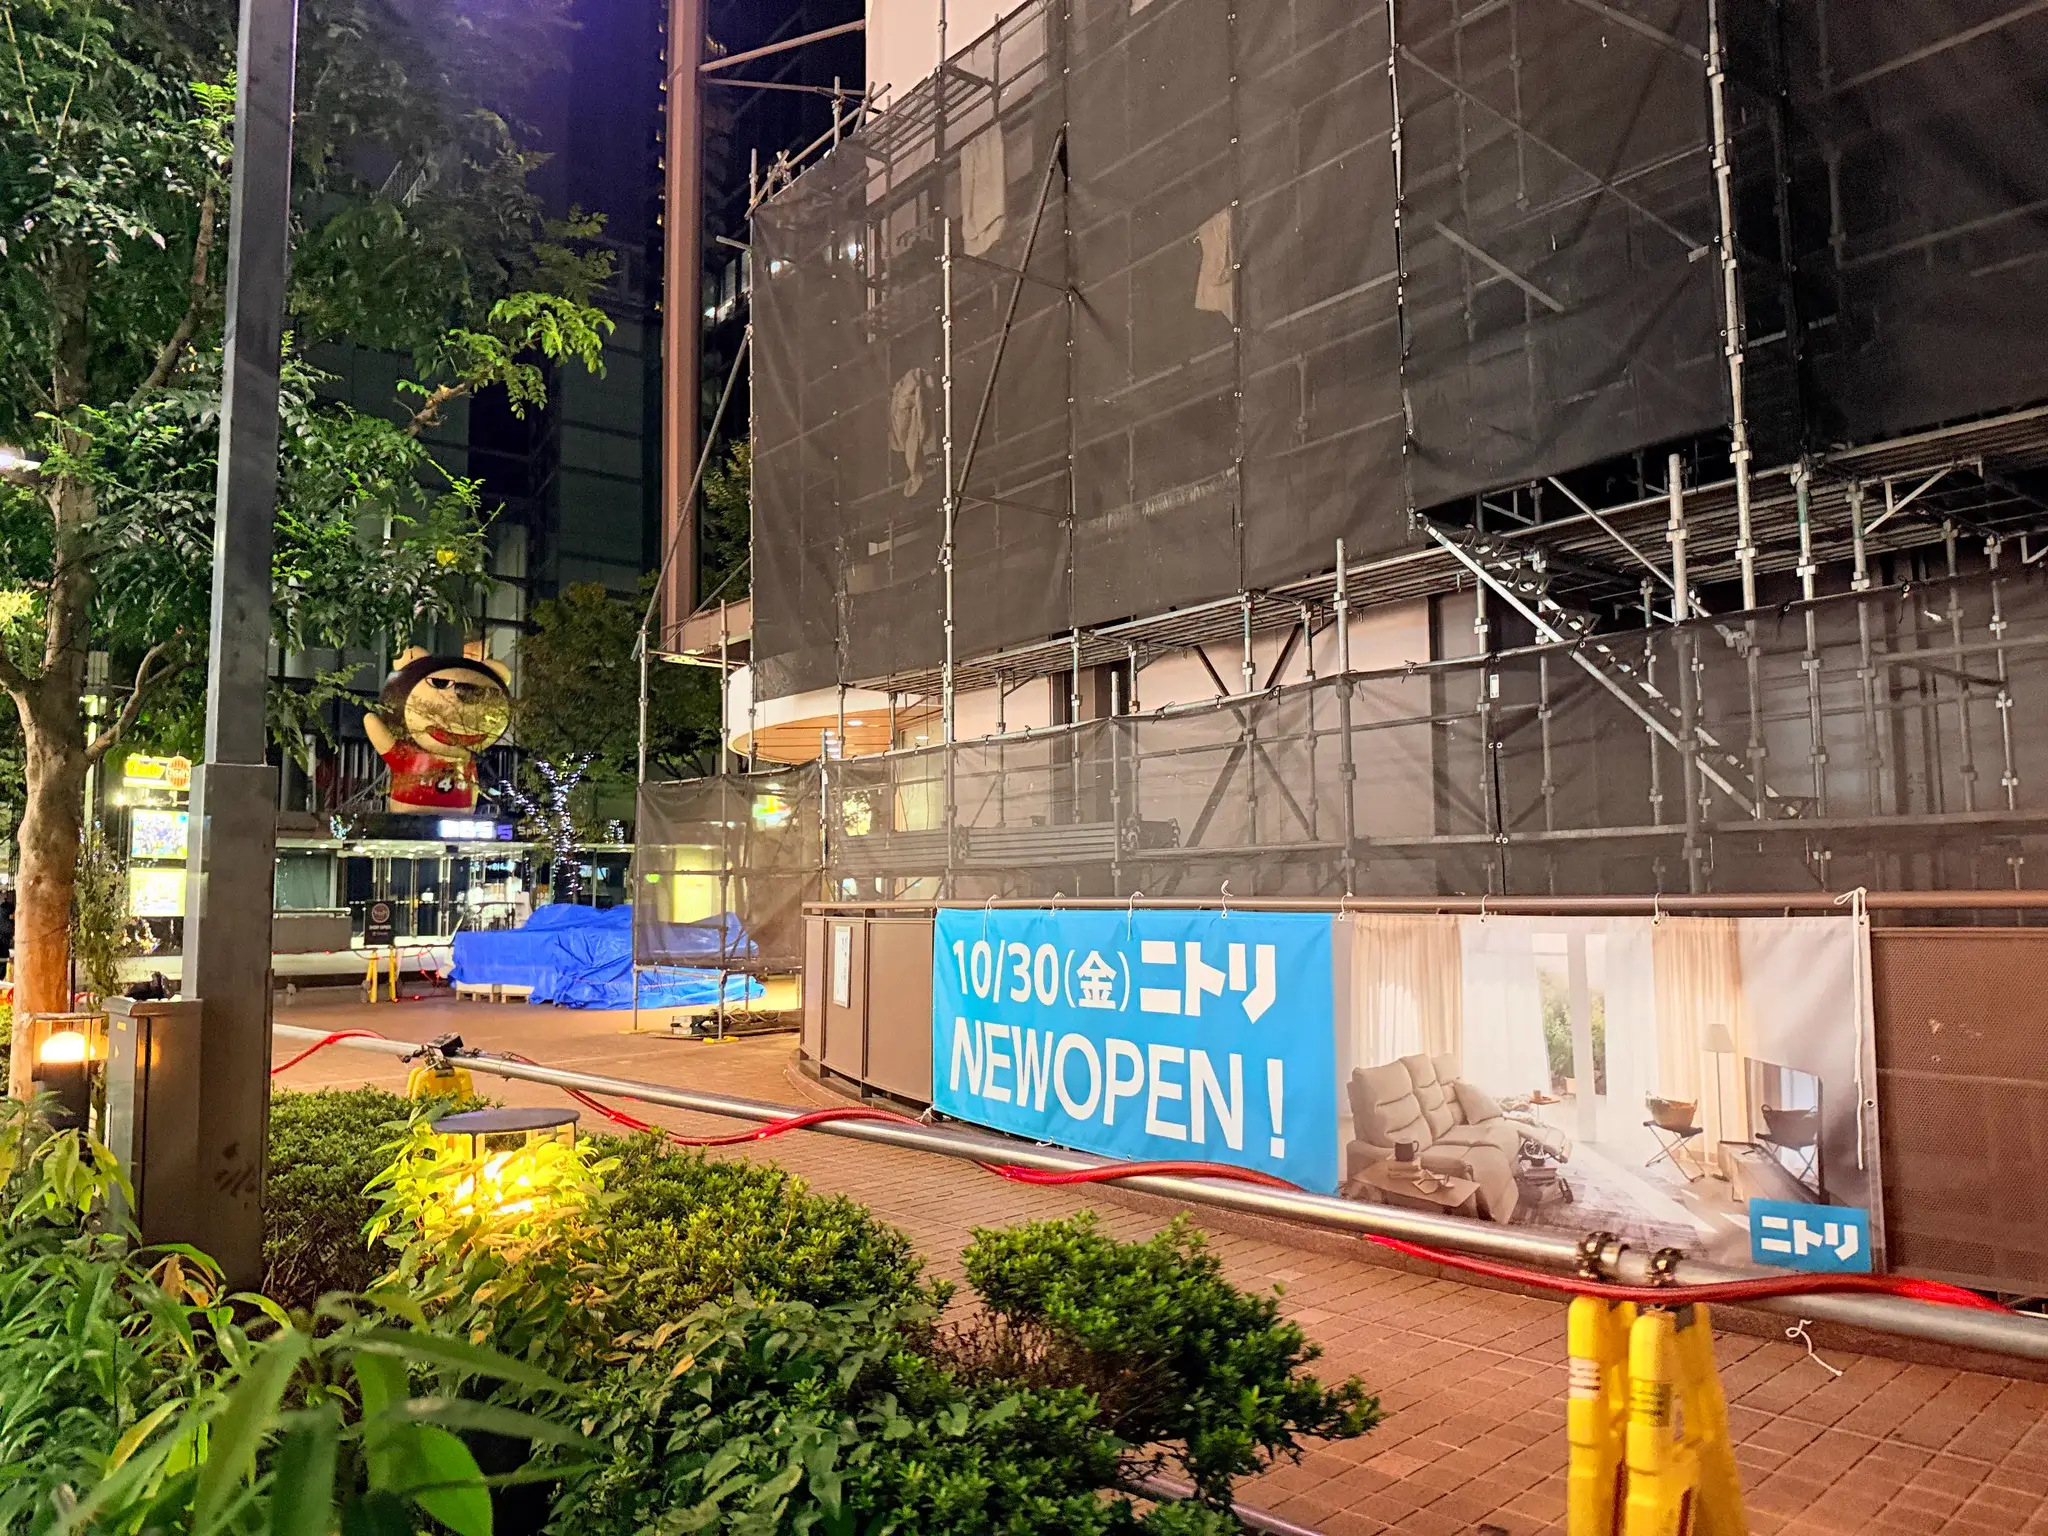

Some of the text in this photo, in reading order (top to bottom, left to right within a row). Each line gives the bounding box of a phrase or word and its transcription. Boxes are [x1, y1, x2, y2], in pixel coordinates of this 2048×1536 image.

[1140, 940, 1277, 1024] ニトリ
[1761, 1215, 1859, 1261] ニトリ
